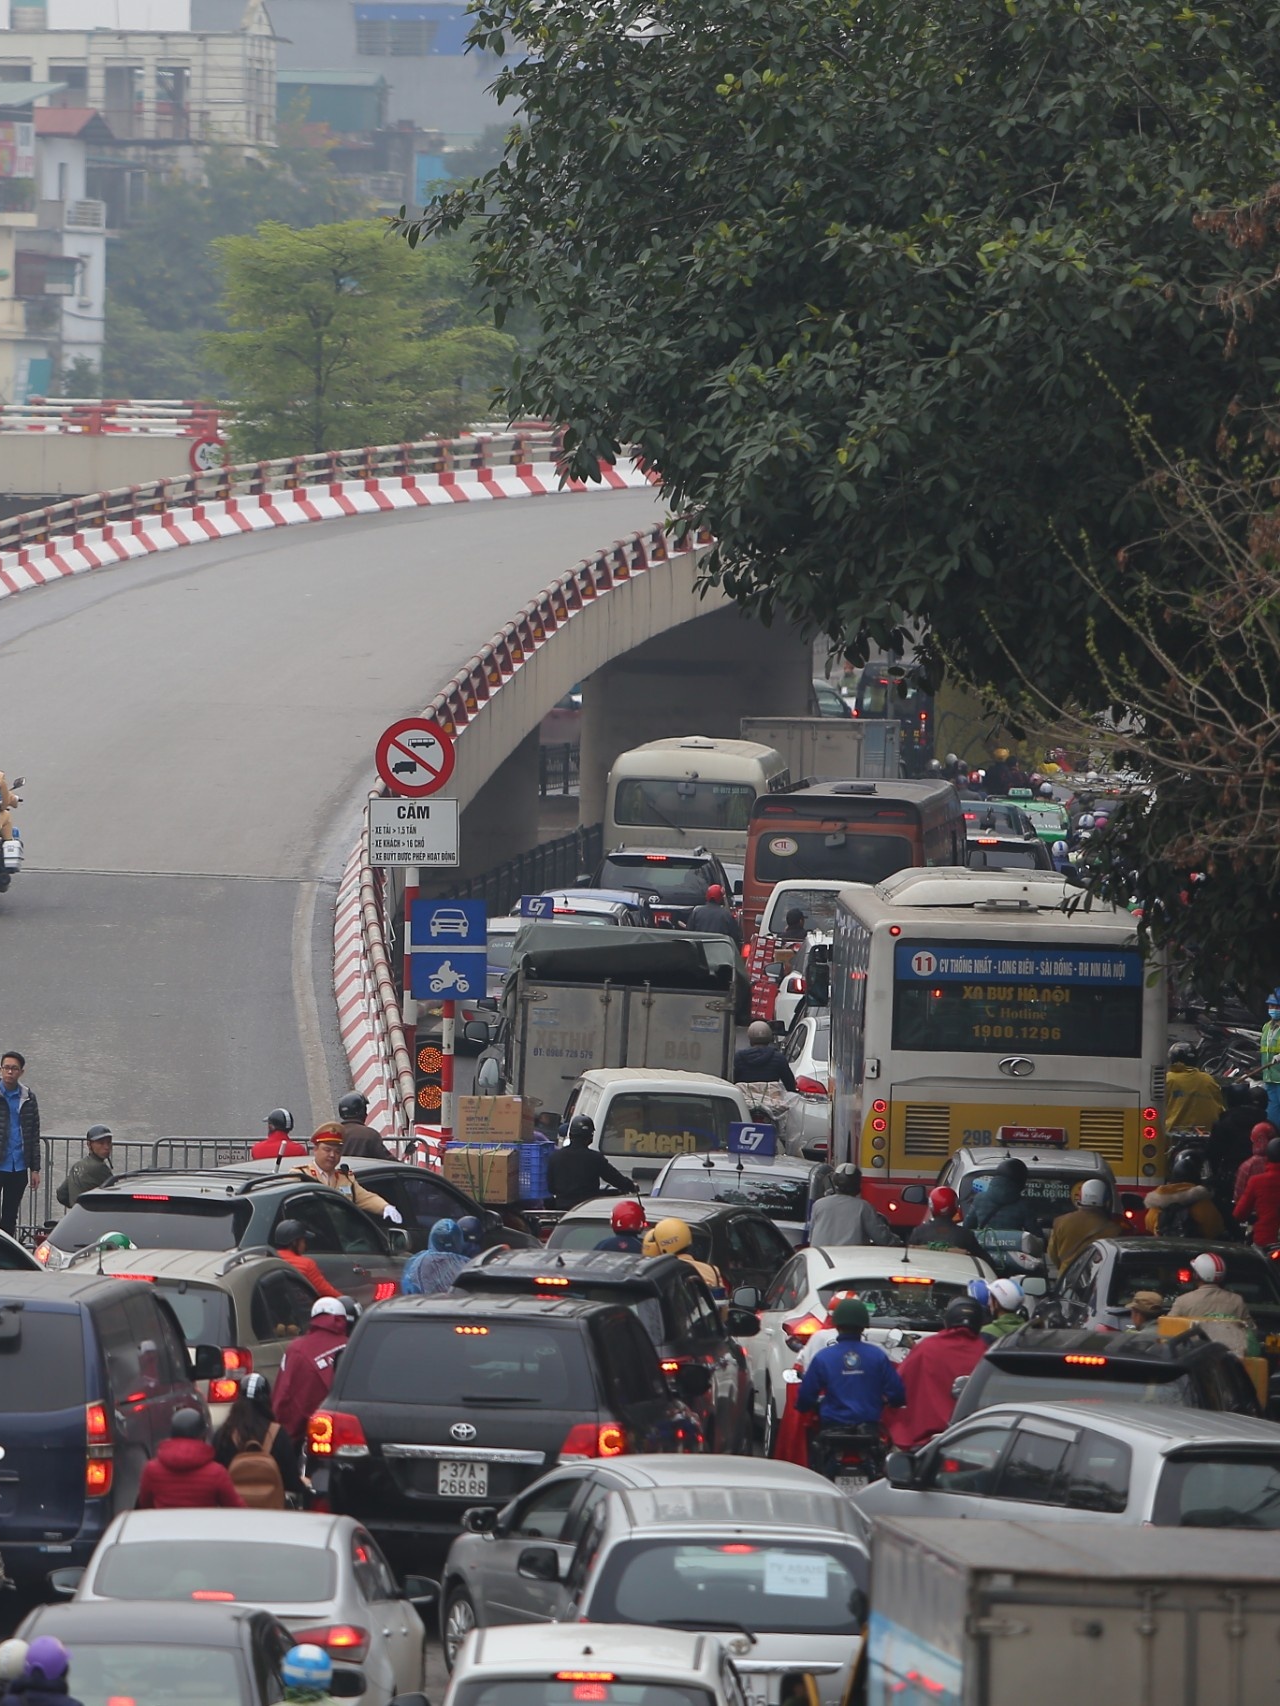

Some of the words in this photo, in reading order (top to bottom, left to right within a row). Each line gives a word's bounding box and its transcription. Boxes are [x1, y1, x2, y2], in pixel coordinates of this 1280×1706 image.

[397, 802, 430, 819] CẤM
[375, 826, 382, 834] XE
[383, 823, 391, 834] TẢI
[375, 840, 382, 848] XE
[383, 838, 400, 848] KHÁCH
[407, 840, 413, 848] 16
[412, 851, 426, 860] PHÉP
[528, 898, 546, 915] G7
[914, 957, 933, 972] 11
[939, 959, 949, 972] CV
[950, 955, 972, 973] THỐNG
[974, 956, 992, 973] NHẤT
[998, 960, 1017, 973] LONG
[1018, 959, 1035, 974] BIÊN
[1040, 958, 1052, 975] SÀI
[1053, 957, 1072, 976] ĐỒNG
[1079, 962, 1089, 976] ĐH
[1091, 963, 1101, 976] NN
[1102, 960, 1112, 977] HÀ
[1113, 960, 1126, 980] NỘI
[987, 986, 1014, 1001] BUS
[1017, 984, 1038, 1002] HÀ
[1043, 985, 1070, 1006] NỘI
[1000, 1007, 1047, 1020] Hotline
[972, 1024, 1062, 1040] 1900.1296
[624, 1128, 696, 1152] Patech
[739, 1127, 764, 1151] G7
[962, 1129, 992, 1146] 29B
[450, 1463, 476, 1478] 37A
[440, 1479, 486, 1495] 268.88
